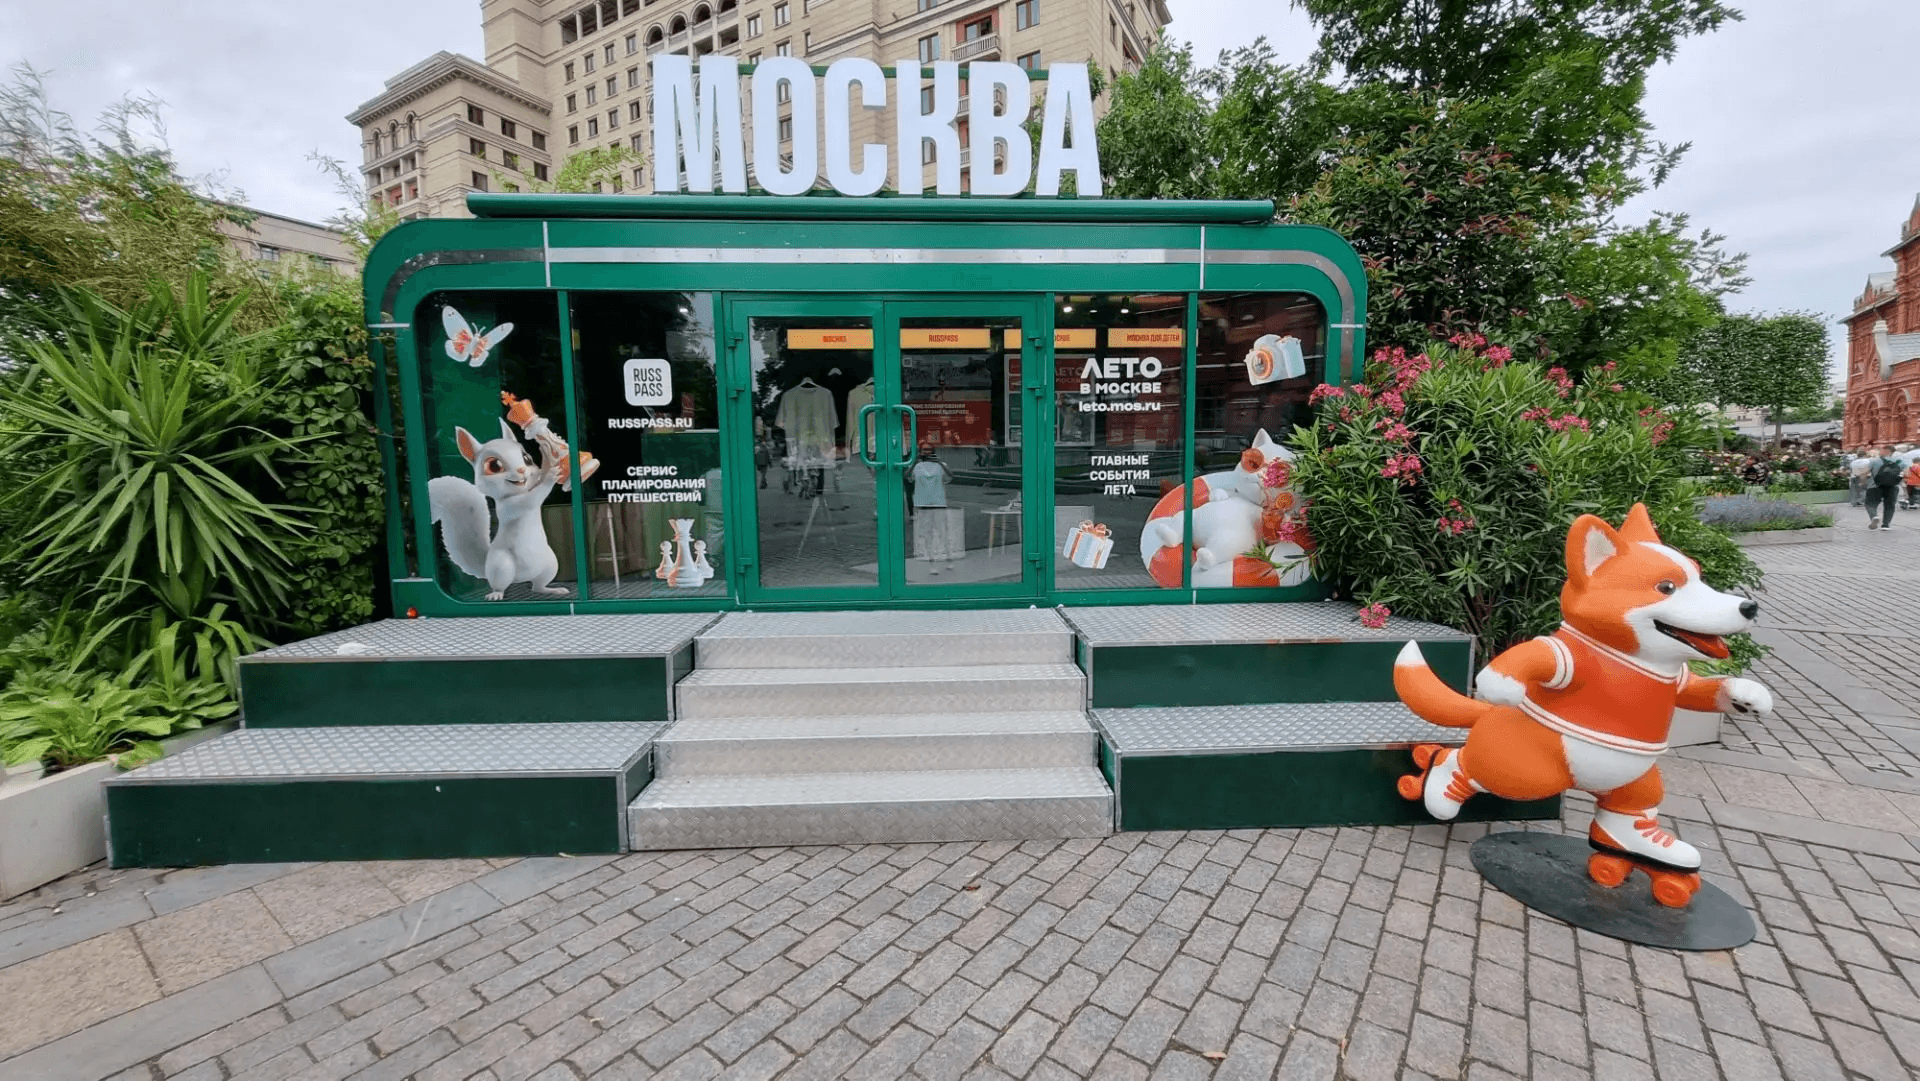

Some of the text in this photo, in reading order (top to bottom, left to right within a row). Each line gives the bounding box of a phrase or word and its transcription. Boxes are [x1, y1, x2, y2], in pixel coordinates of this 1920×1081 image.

[653, 54, 1103, 197] МОСКВА
[1080, 356, 1163, 379] ЛЕТО
[633, 367, 662, 382] RUSS
[634, 383, 663, 397] PASS
[1080, 382, 1162, 394] В МОСКВЕ
[1078, 401, 1161, 412] leto.mos.ru
[608, 418, 693, 429] RUSSPASS.RU
[1091, 455, 1149, 466] ГЛАВНЫЕ
[626, 465, 678, 476] СЕРВИС
[1089, 469, 1150, 481] СОБЫТИЯ
[602, 478, 706, 490] ПЛАНИРОВАНИЯ
[1103, 484, 1136, 495] ЛЕТА
[608, 491, 702, 503] ПУТЕШЕСТВИЙ
